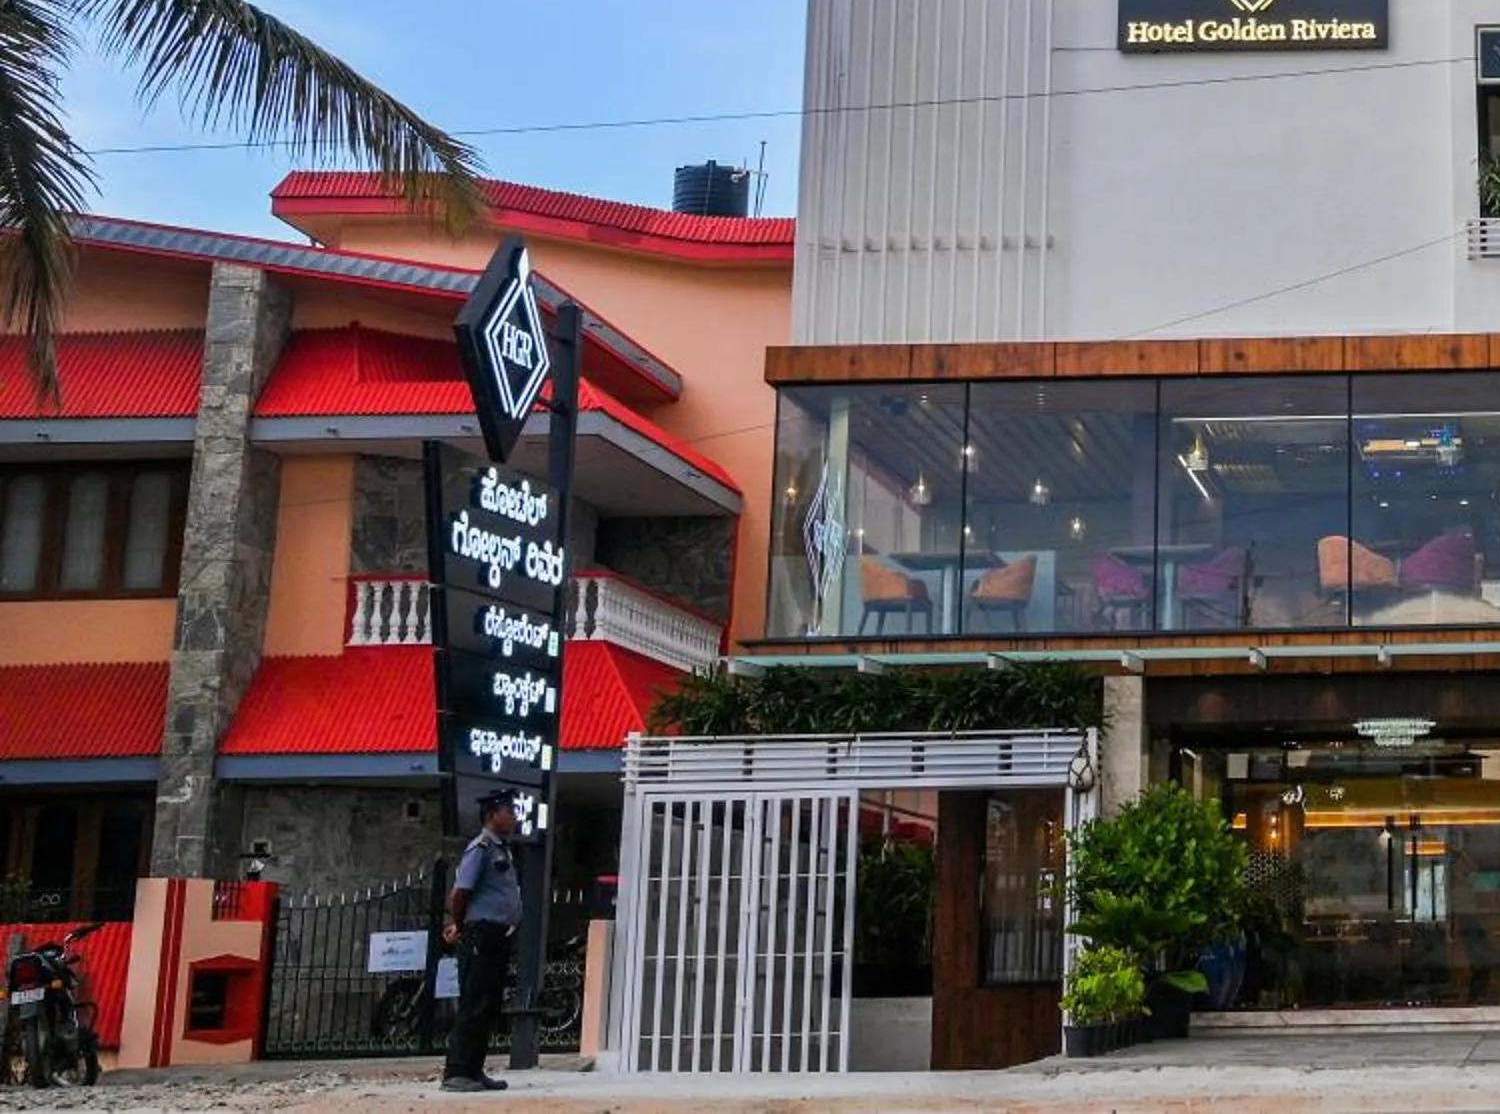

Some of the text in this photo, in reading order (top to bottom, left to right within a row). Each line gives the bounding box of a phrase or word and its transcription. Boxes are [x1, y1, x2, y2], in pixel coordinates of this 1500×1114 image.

[1127, 18, 1377, 43] Hotel Golden Riviera
[502, 321, 533, 370] HGR
